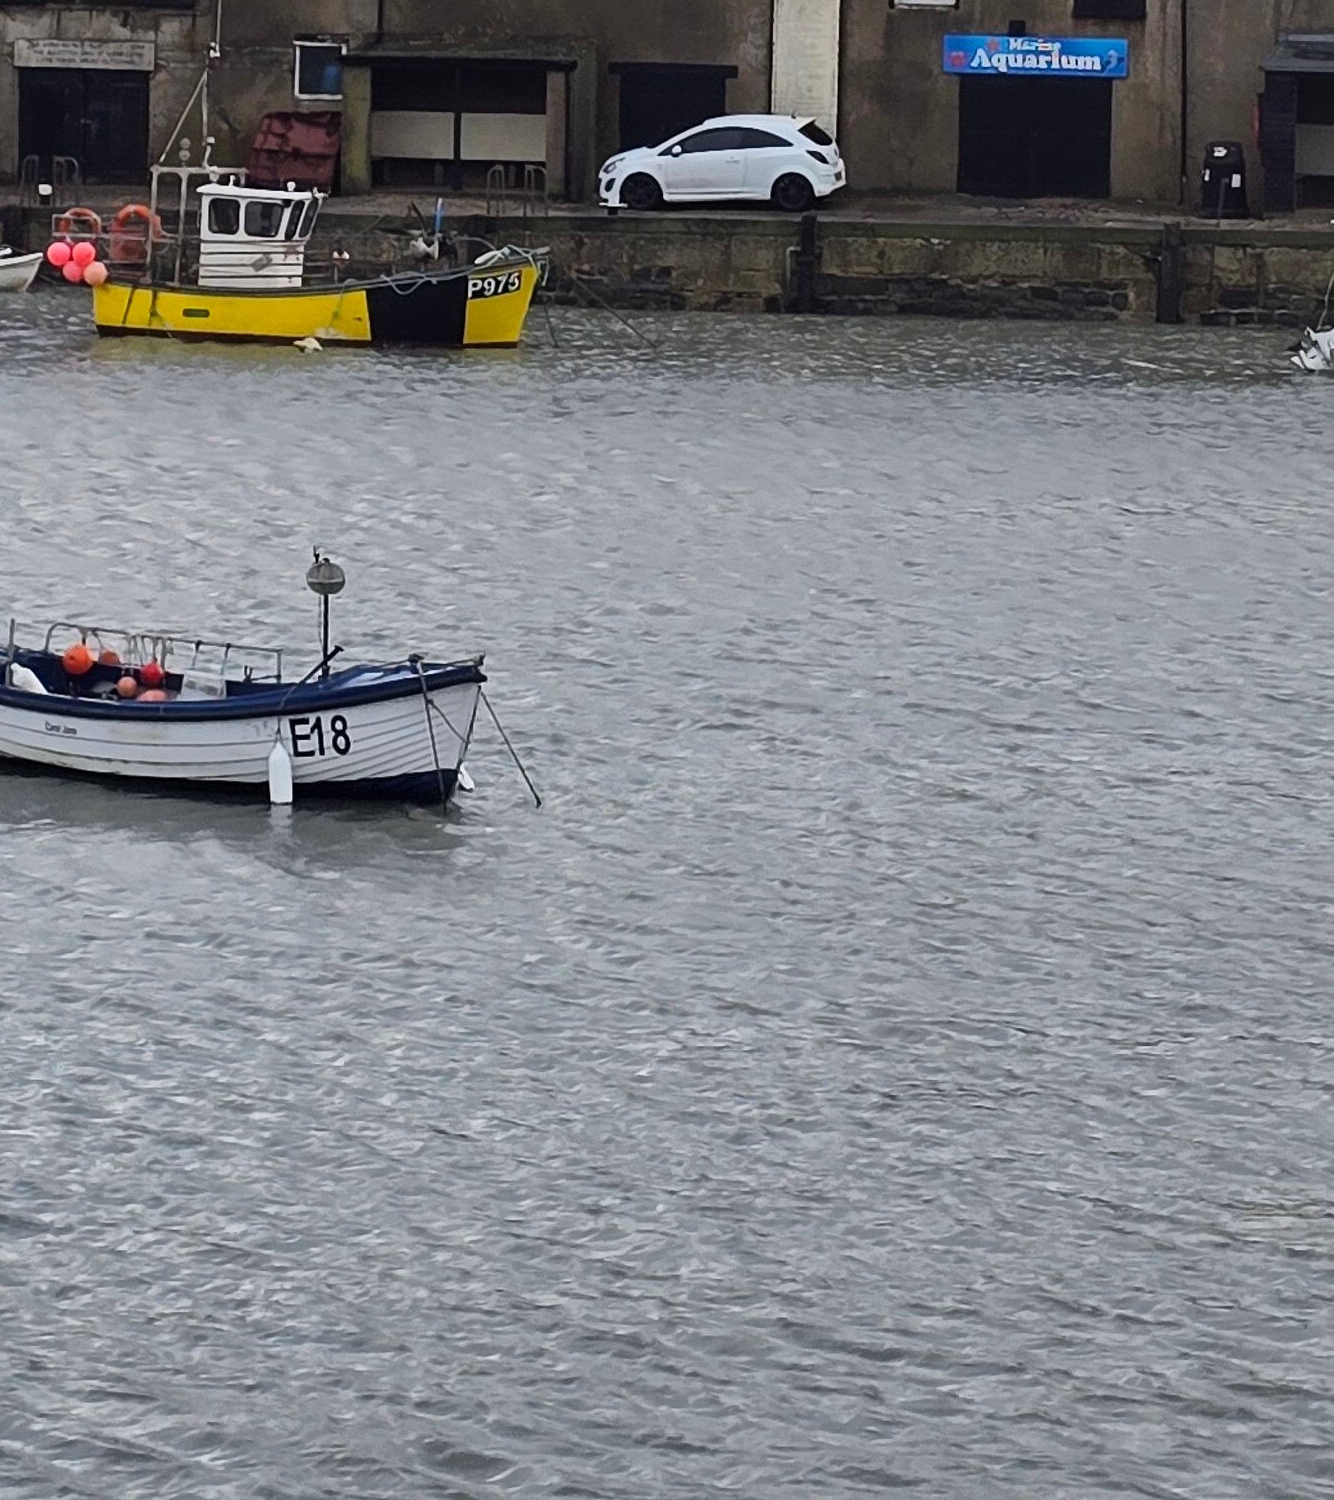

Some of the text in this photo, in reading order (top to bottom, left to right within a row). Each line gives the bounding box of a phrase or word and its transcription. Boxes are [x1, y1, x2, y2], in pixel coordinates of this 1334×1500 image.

[970, 48, 1102, 73] Aquarium
[468, 272, 519, 299] P975
[288, 714, 352, 758] E18
